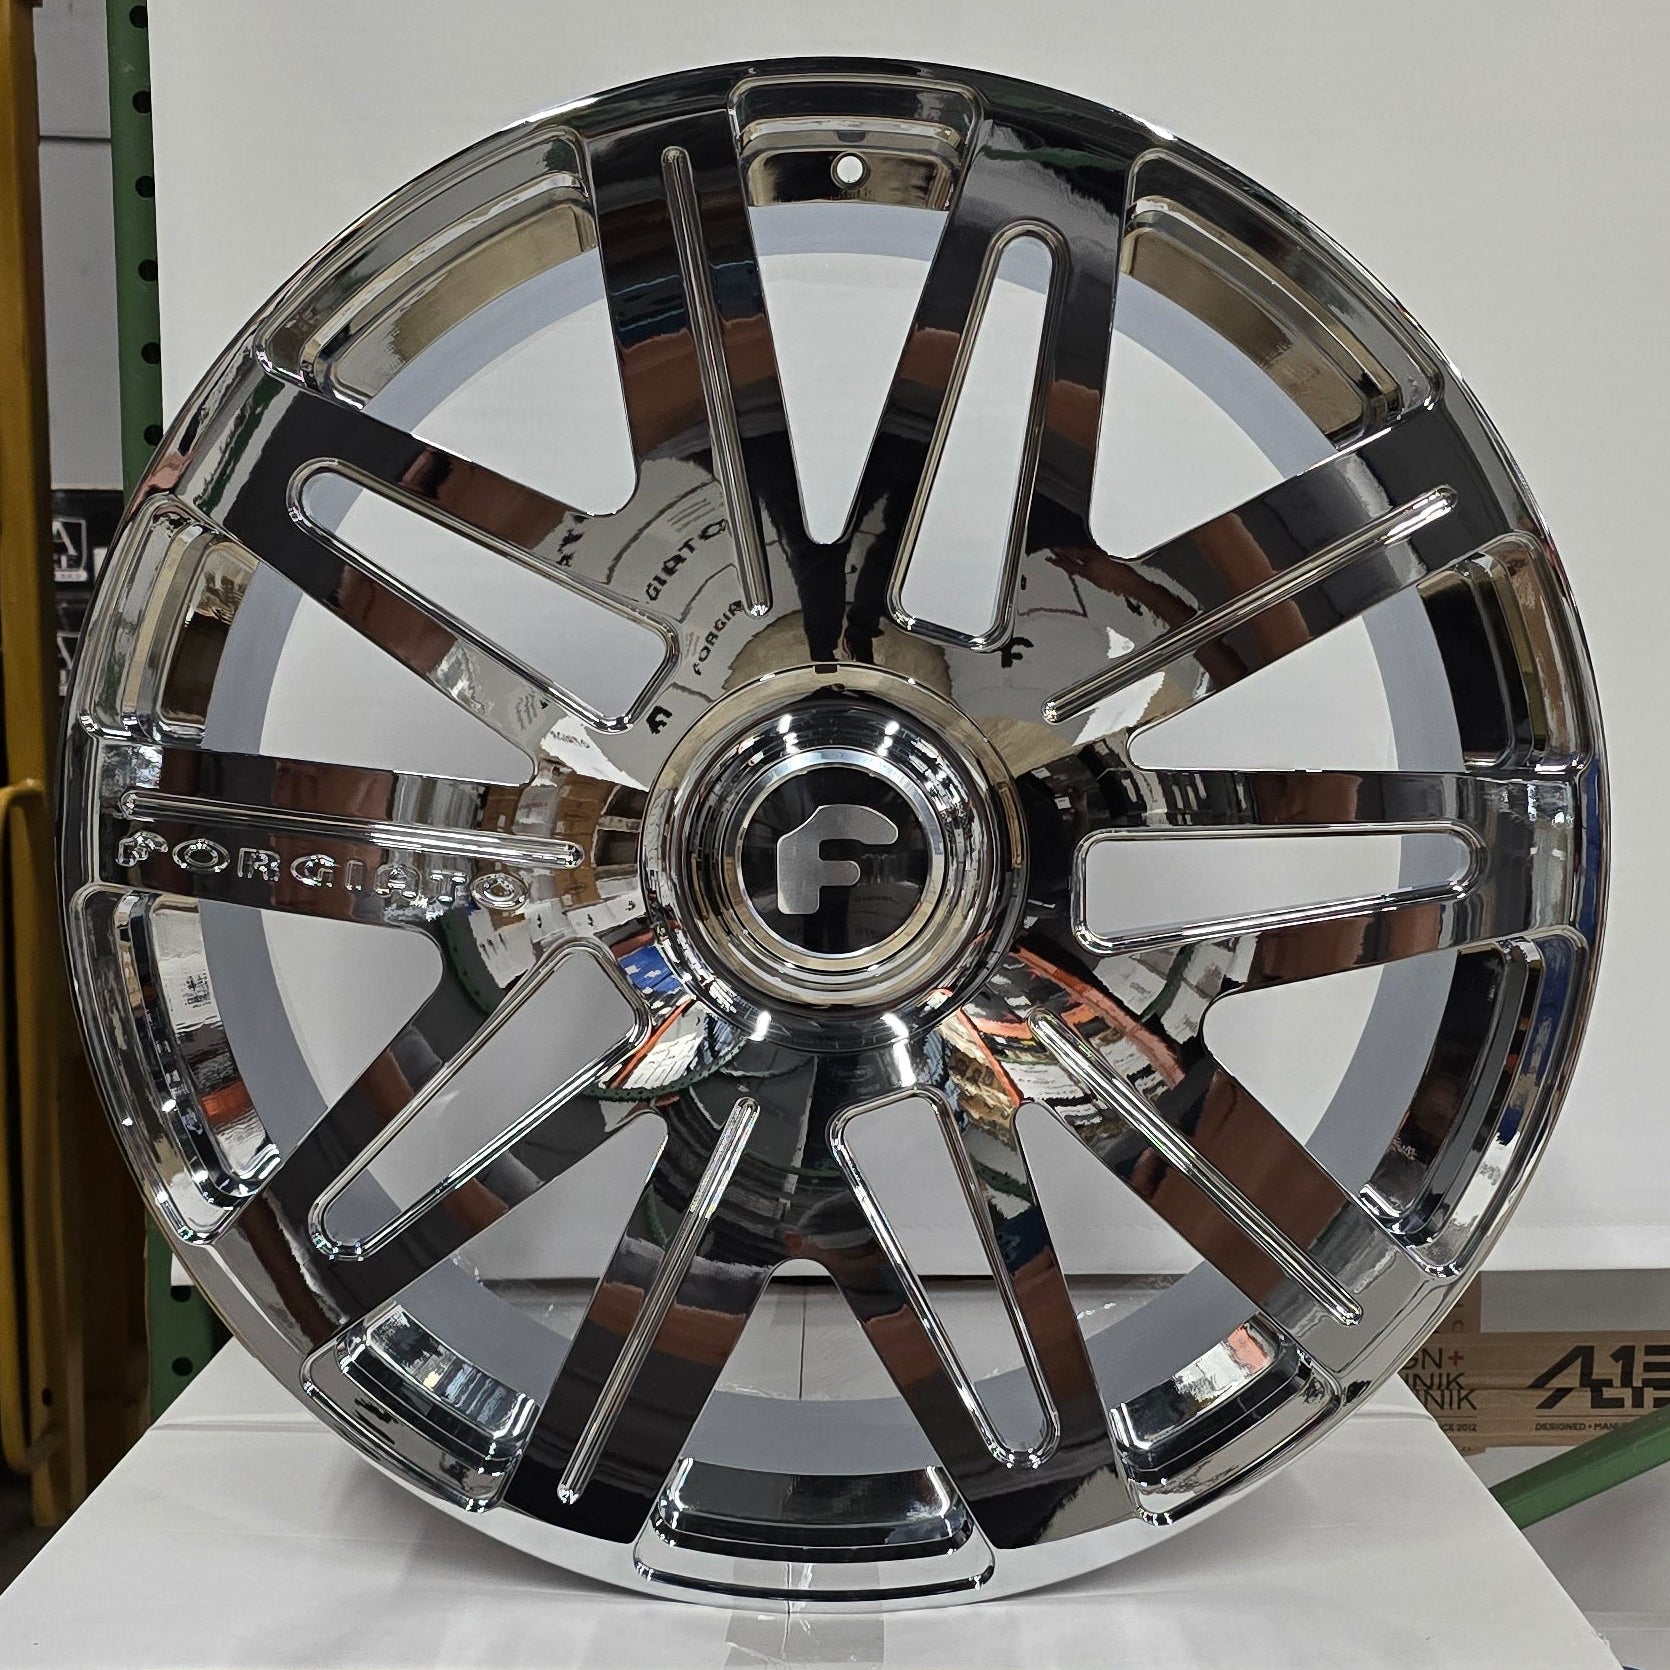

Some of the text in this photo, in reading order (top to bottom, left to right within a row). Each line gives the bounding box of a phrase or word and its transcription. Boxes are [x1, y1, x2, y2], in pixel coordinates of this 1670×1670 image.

[115, 831, 530, 911] FORGIATO
[1456, 1423, 1478, 1432] 2012
[1535, 1422, 1586, 1431] DESIGNED
